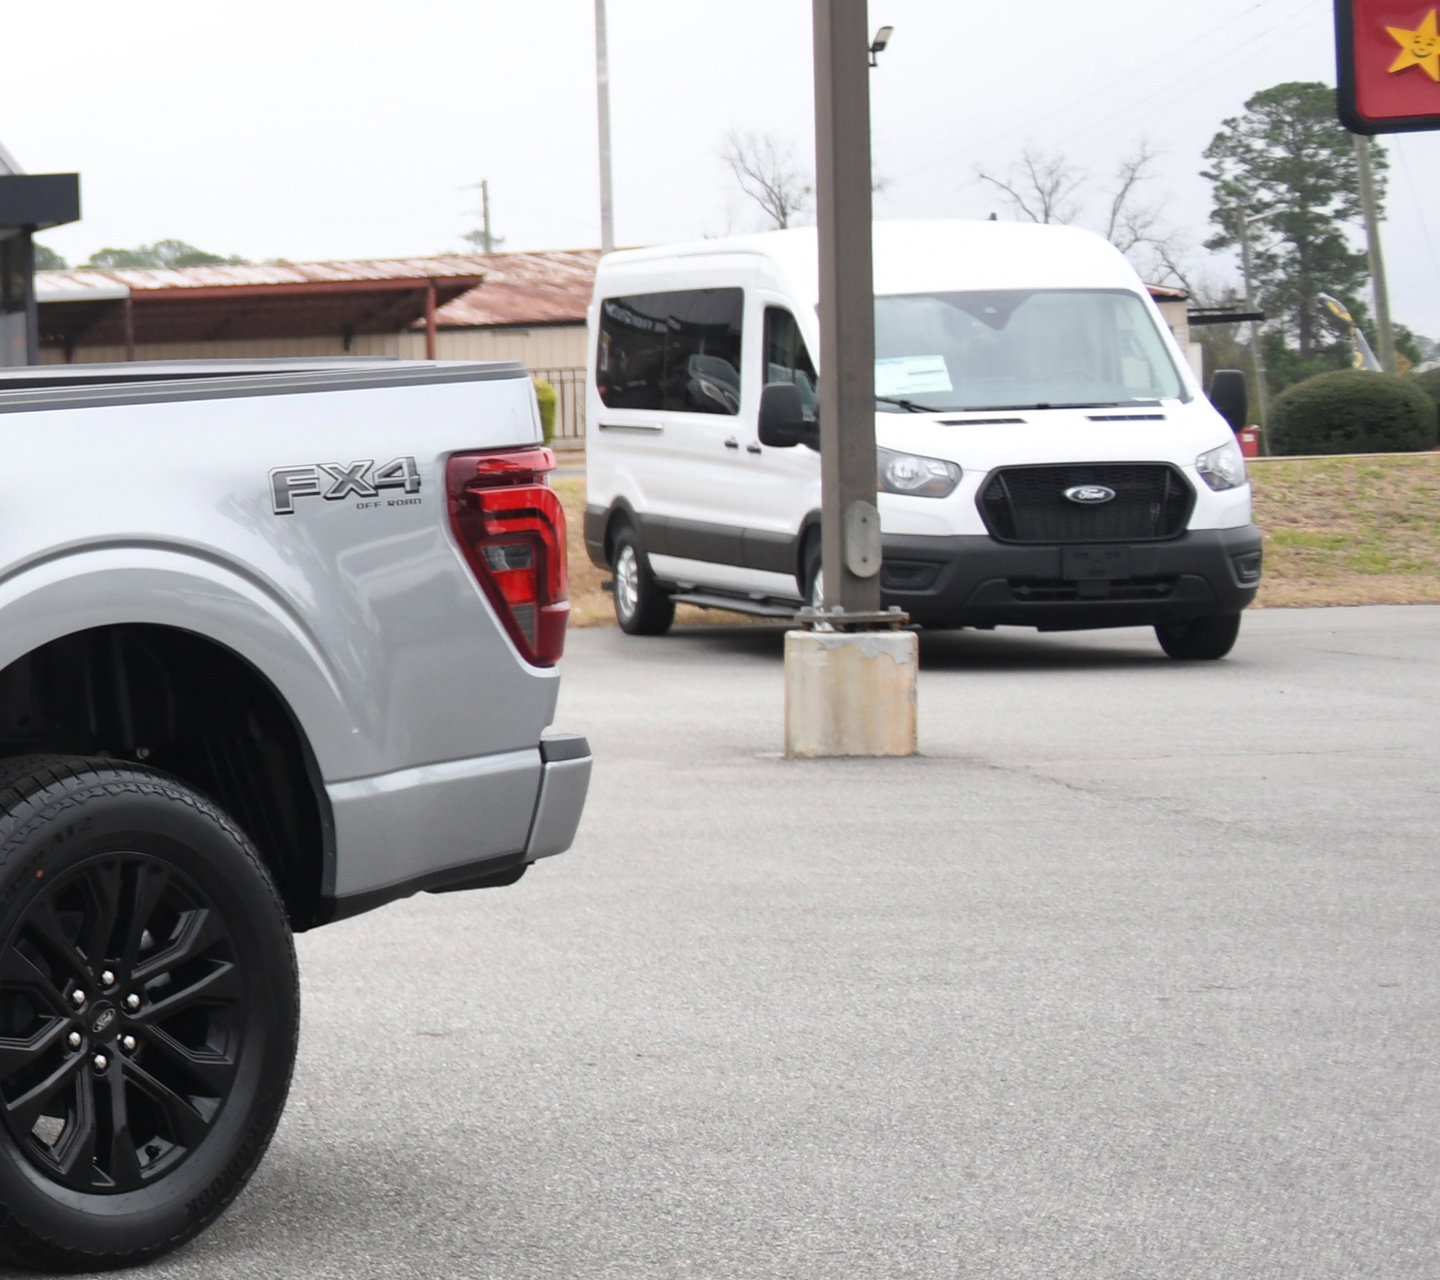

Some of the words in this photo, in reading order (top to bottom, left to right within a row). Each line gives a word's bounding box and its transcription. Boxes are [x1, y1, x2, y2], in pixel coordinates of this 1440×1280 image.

[268, 456, 422, 515] FX4
[356, 502, 382, 510] OFF
[387, 497, 422, 507] ROAD
